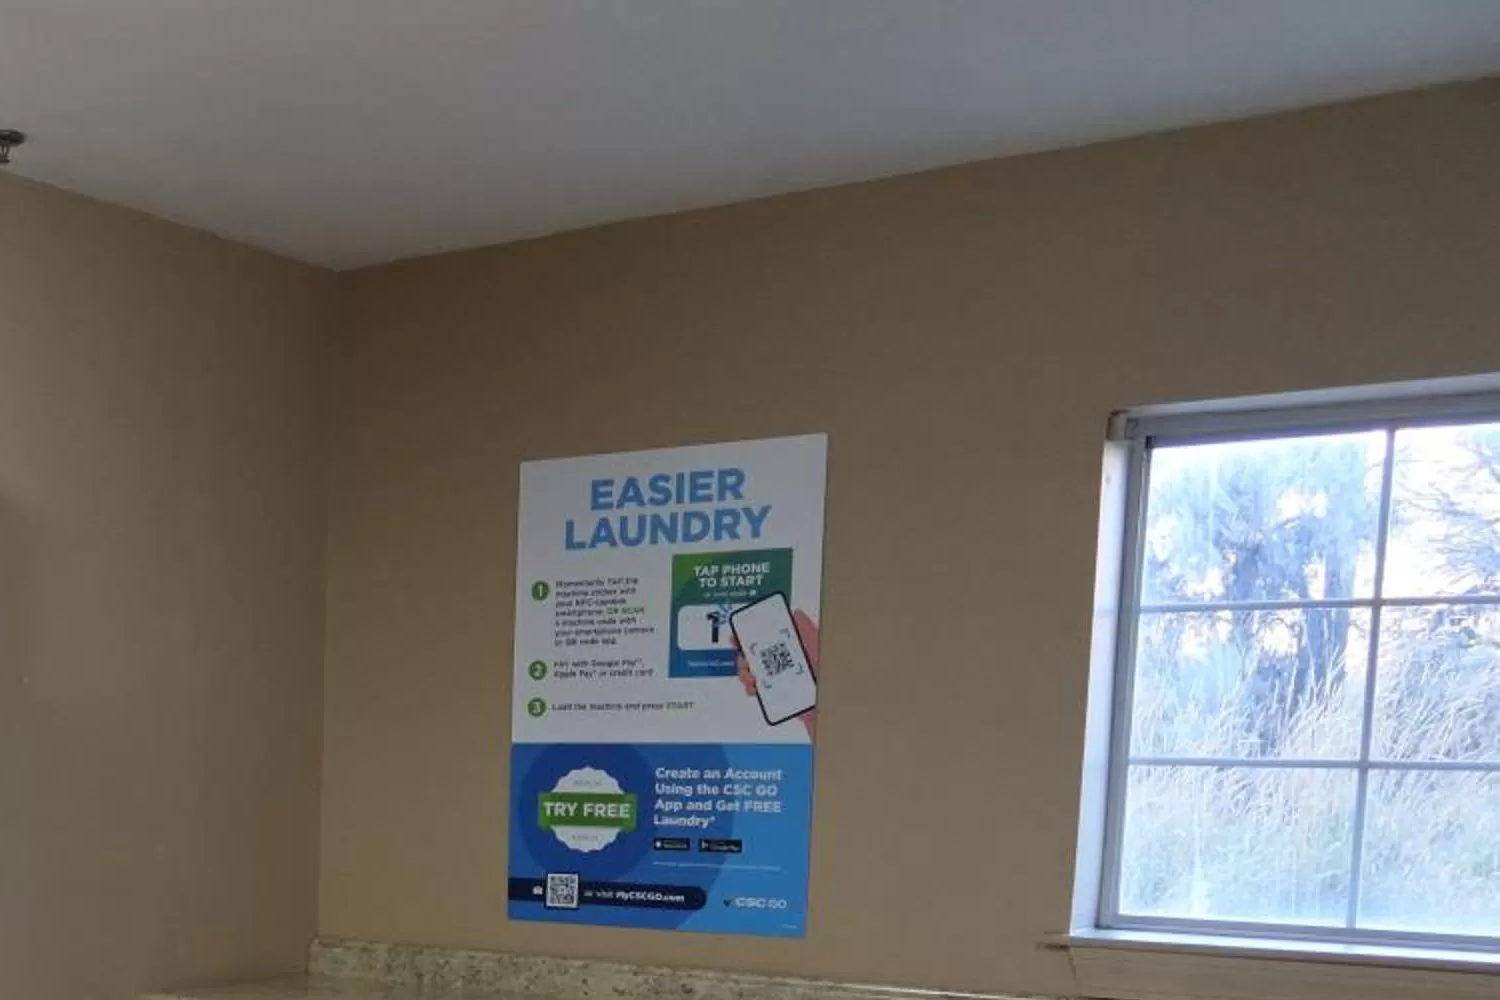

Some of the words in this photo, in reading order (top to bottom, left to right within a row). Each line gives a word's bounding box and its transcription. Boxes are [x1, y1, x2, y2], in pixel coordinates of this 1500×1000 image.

[590, 467, 746, 511] EASIER
[564, 505, 773, 550] LAUNDRY
[693, 565, 719, 577] TAP
[722, 561, 771, 575] PHONE
[699, 577, 717, 588] TO
[720, 574, 765, 587] START
[706, 611, 720, 643] 1
[655, 767, 699, 780] Create
[703, 769, 720, 780] an
[724, 768, 784, 781] Account
[655, 783, 693, 797] Using
[696, 784, 719, 796] the
[723, 784, 751, 796] CSC
[755, 785, 778, 797] GO
[543, 801, 577, 817] TRY
[583, 803, 631, 819] FREE
[655, 799, 683, 814] App
[686, 800, 712, 812] and
[716, 800, 740, 813] Get
[743, 801, 782, 814] FREE
[615, 891, 685, 903] MyCSCGO.com
[770, 899, 788, 910] GO
